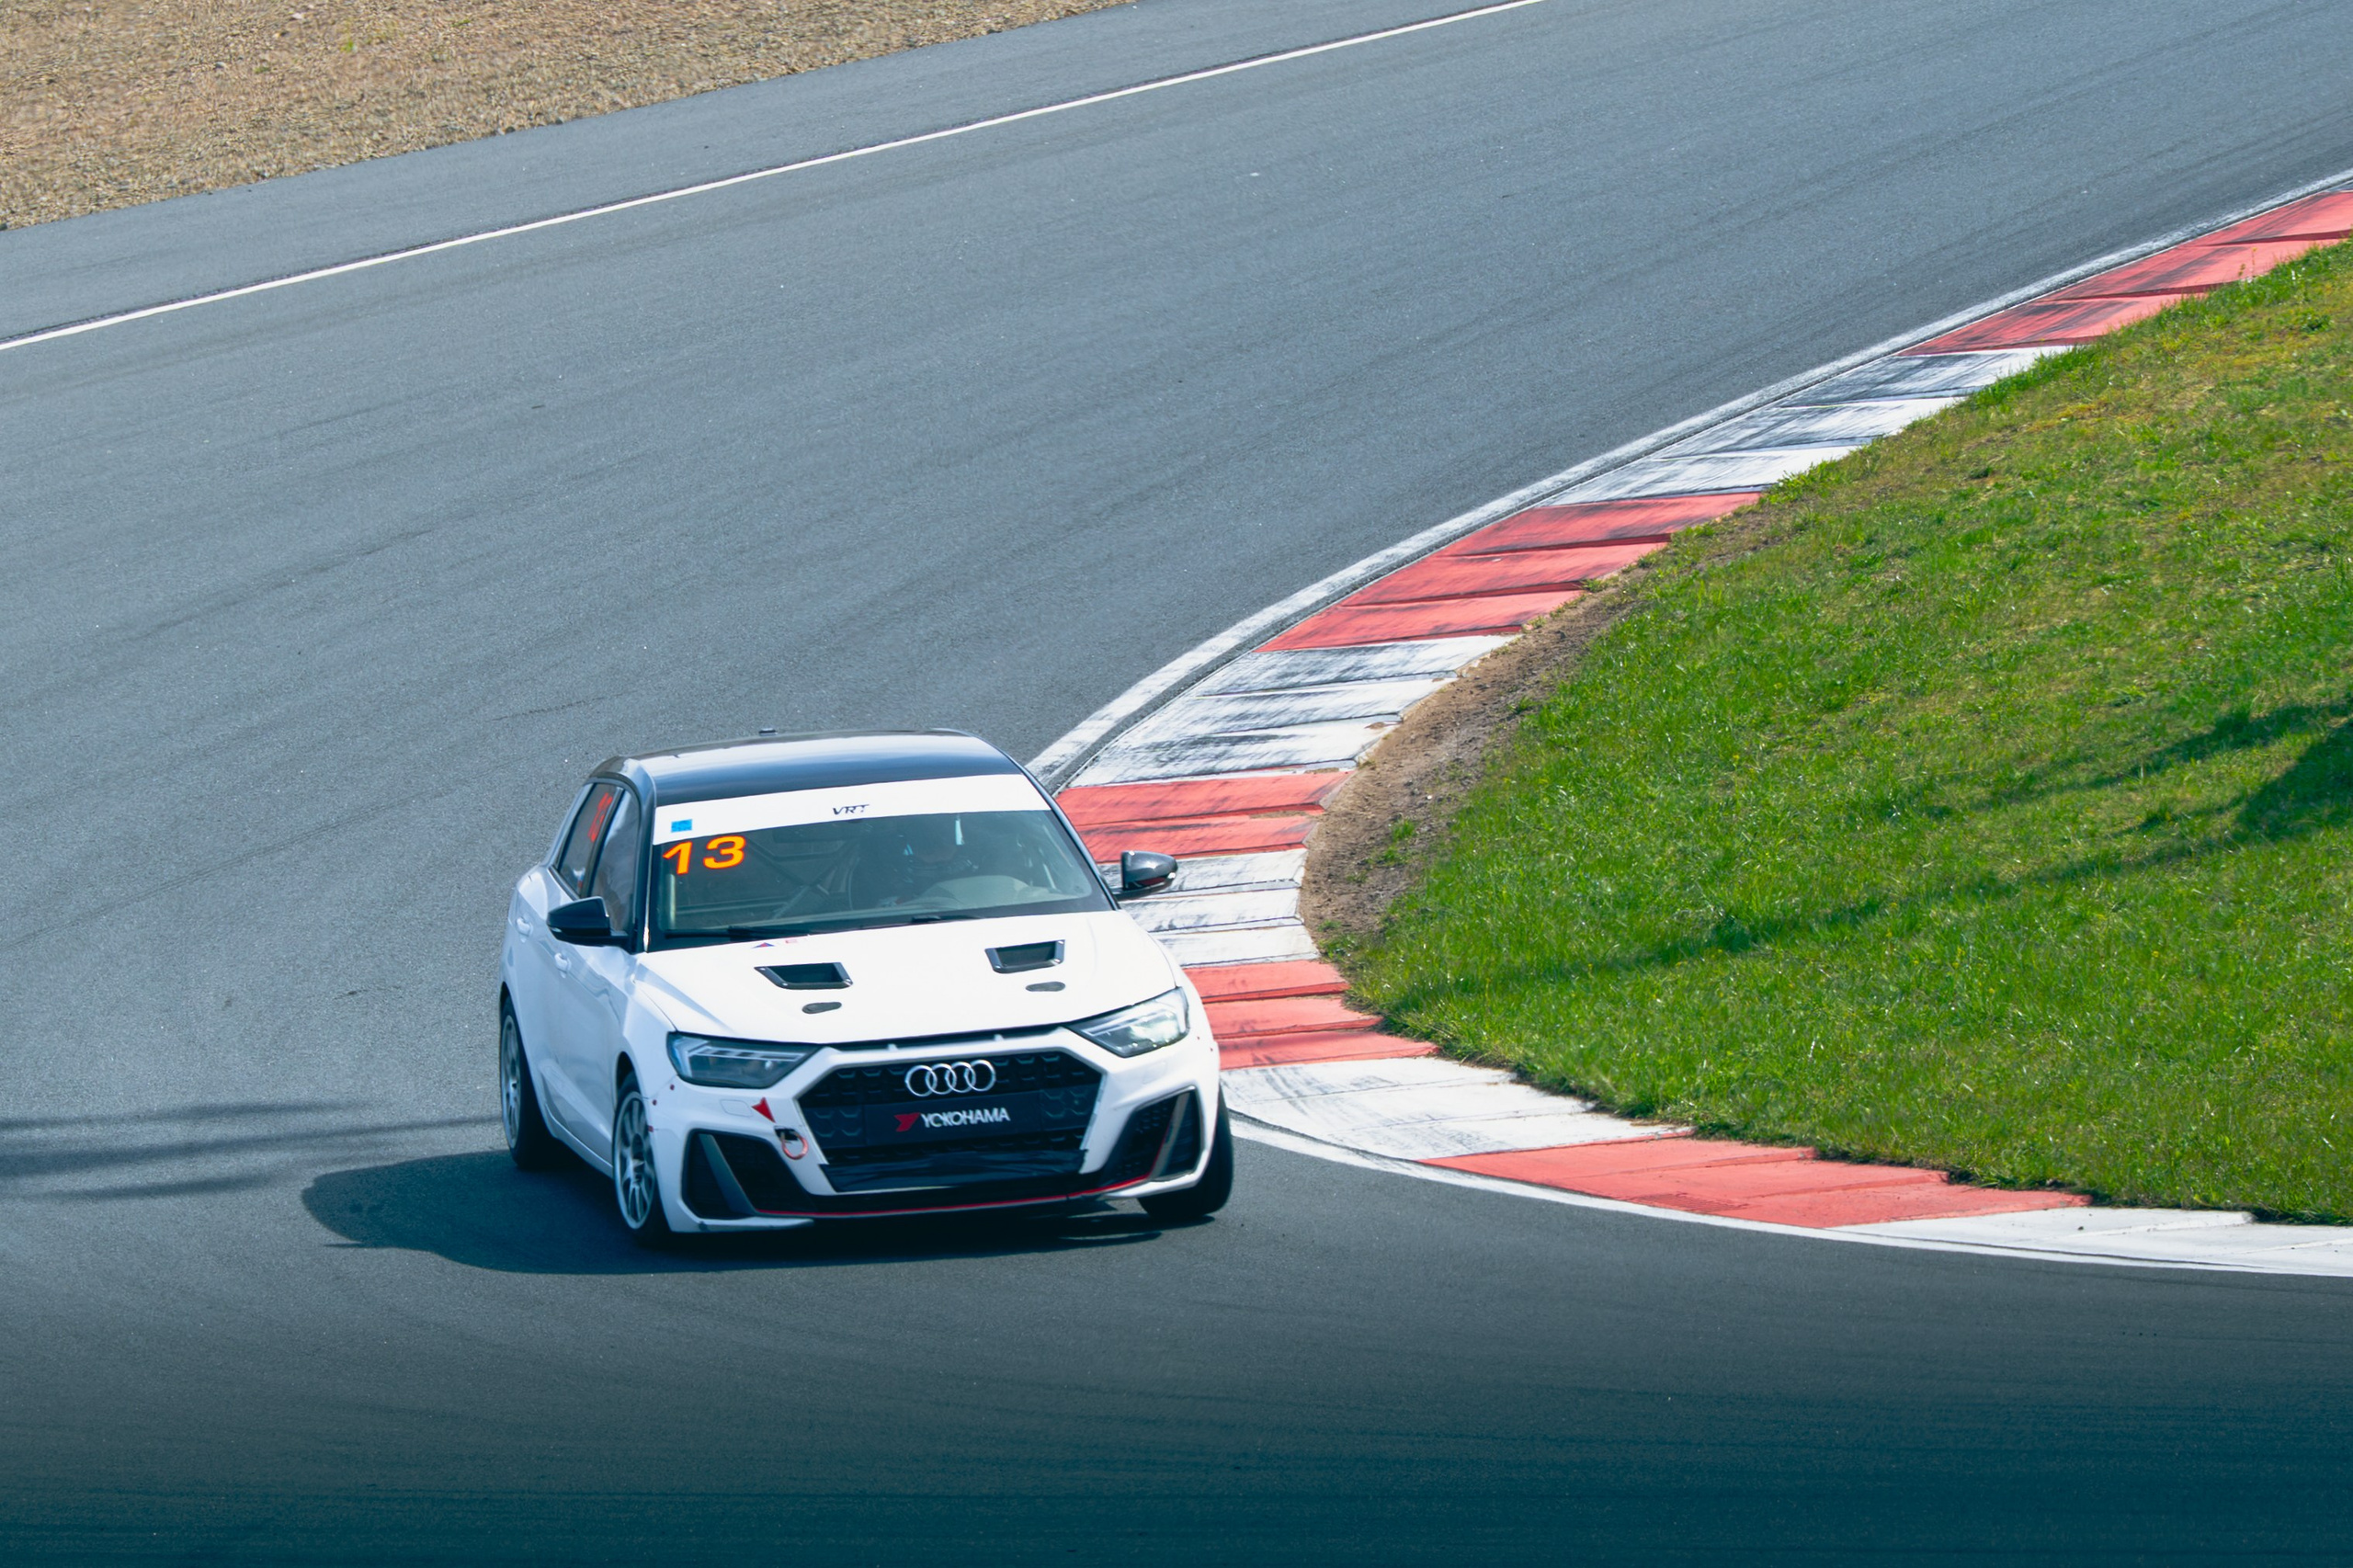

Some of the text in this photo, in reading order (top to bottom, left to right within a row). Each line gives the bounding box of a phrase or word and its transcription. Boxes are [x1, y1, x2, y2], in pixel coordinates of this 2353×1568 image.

[832, 803, 870, 815] VRT
[662, 835, 746, 875] 13
[920, 1107, 1011, 1129] YOKOHAMA
